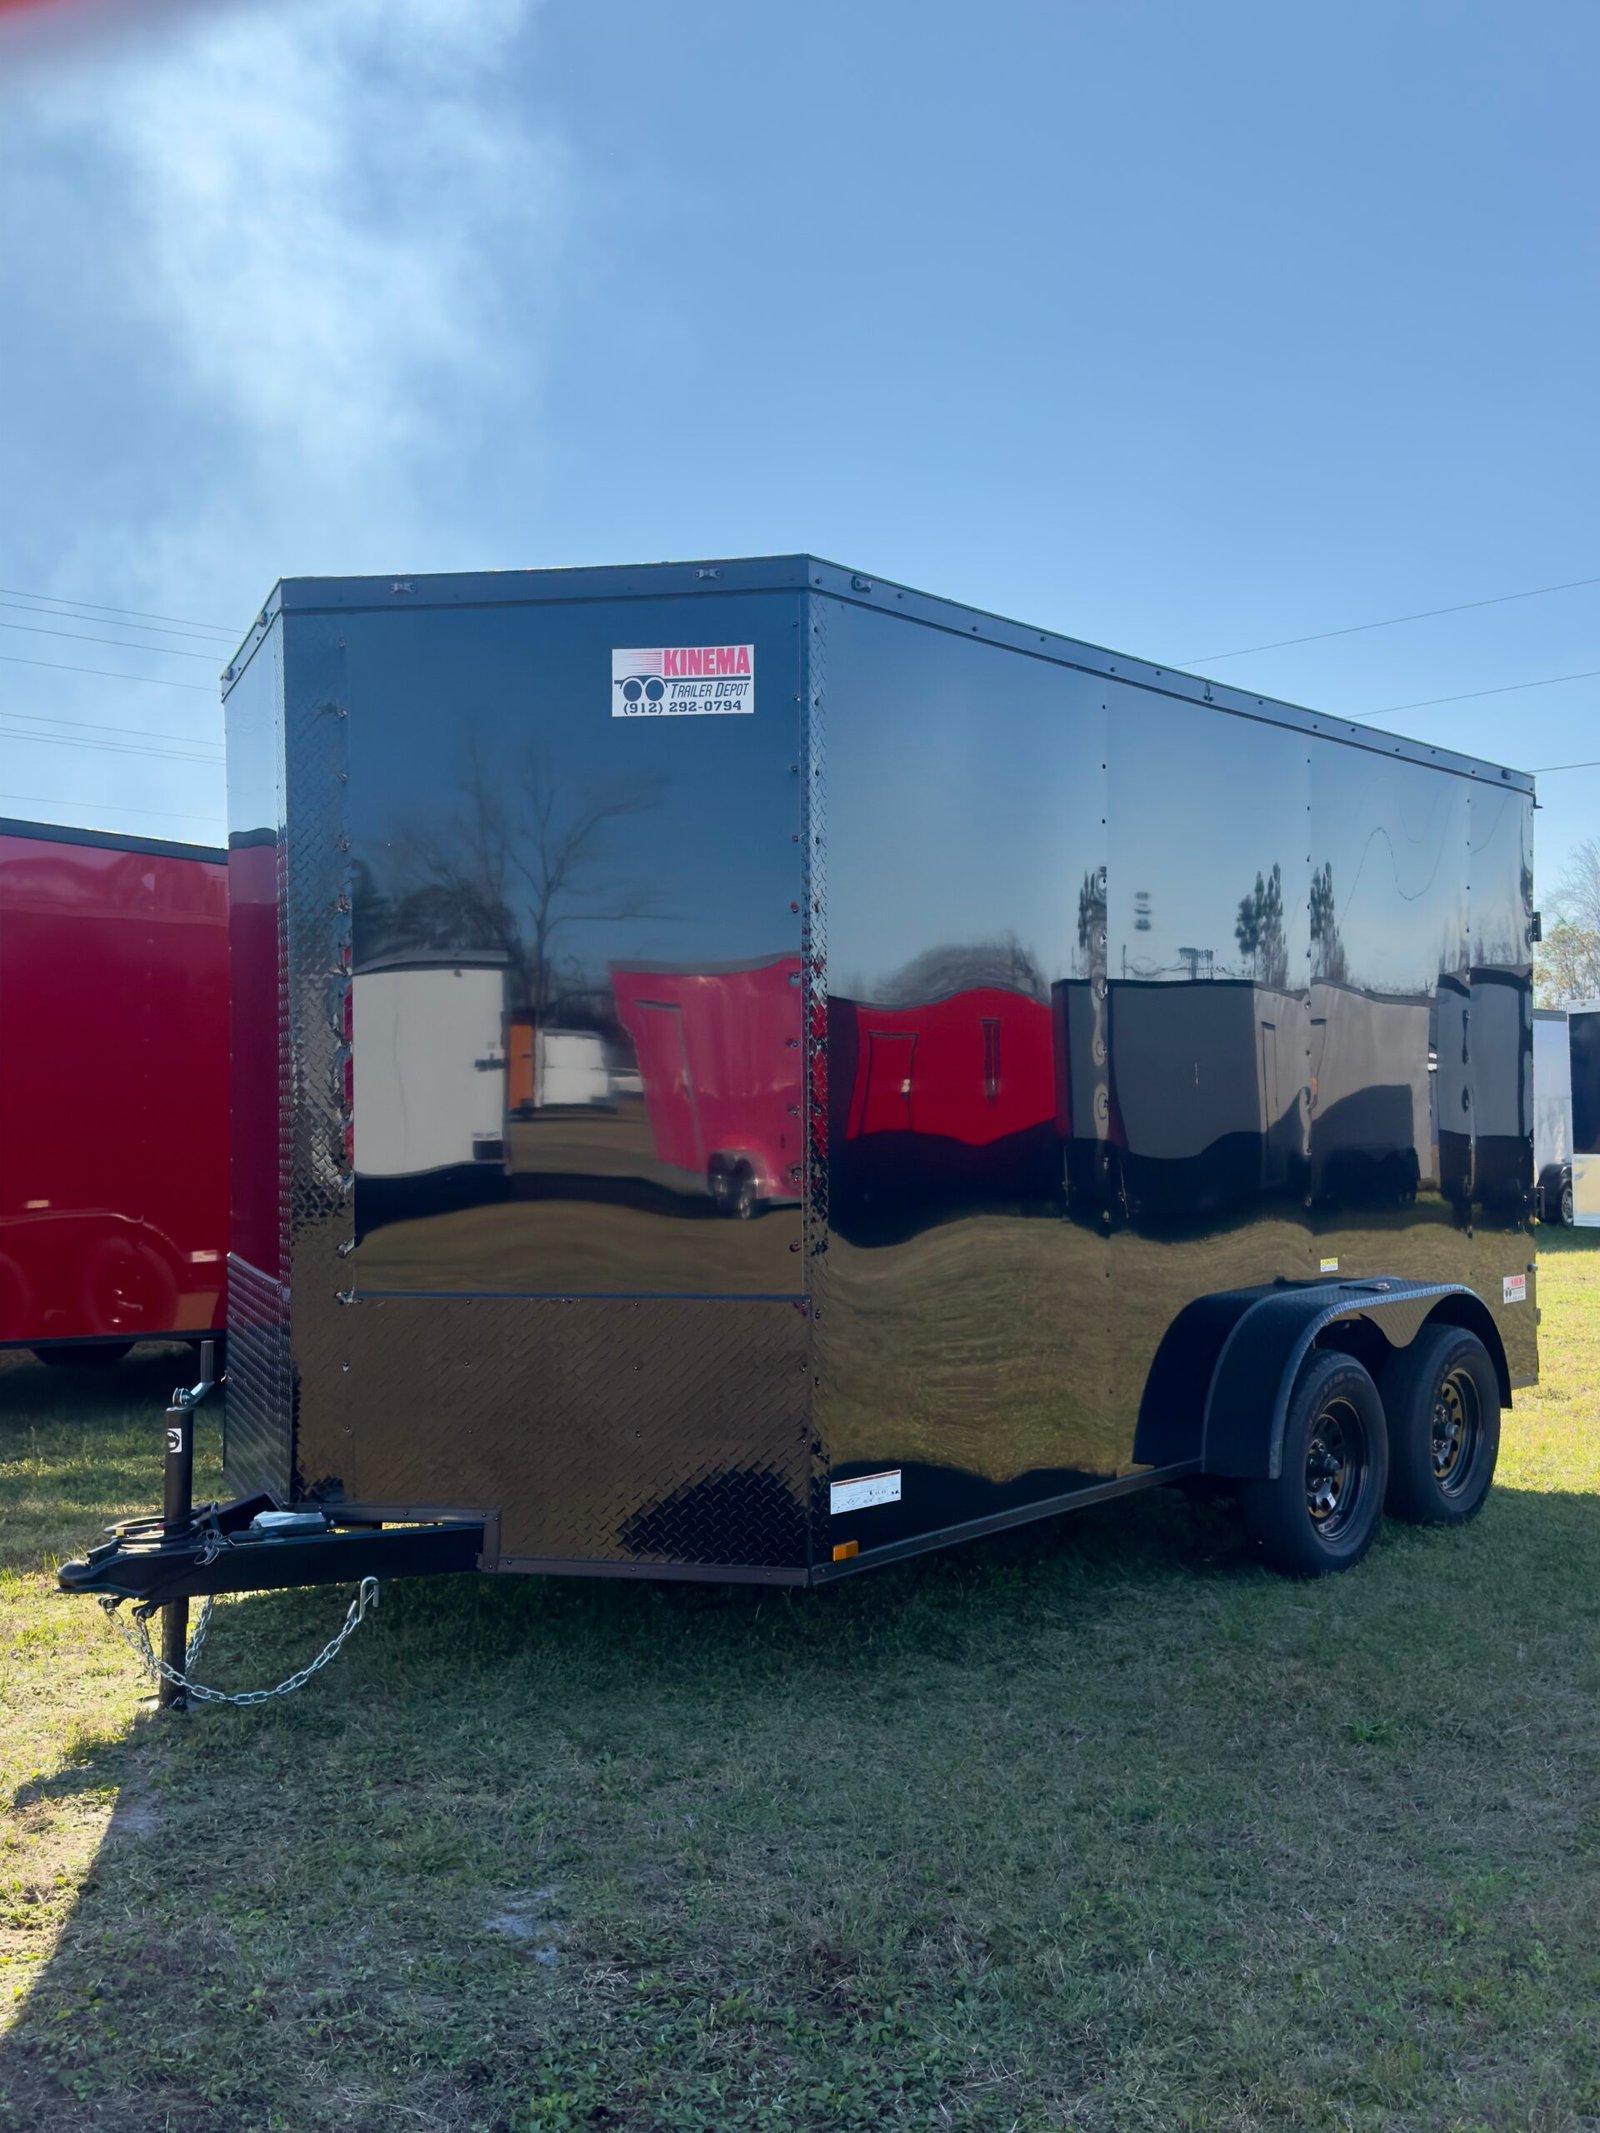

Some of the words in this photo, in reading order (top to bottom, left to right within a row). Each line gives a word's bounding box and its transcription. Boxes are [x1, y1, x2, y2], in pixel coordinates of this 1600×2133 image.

[664, 647, 751, 676] KINEMA
[671, 683, 712, 699] TRAILER
[715, 682, 750, 698] DEPOT
[624, 701, 664, 715] (912)
[669, 700, 742, 713] 292-0794
